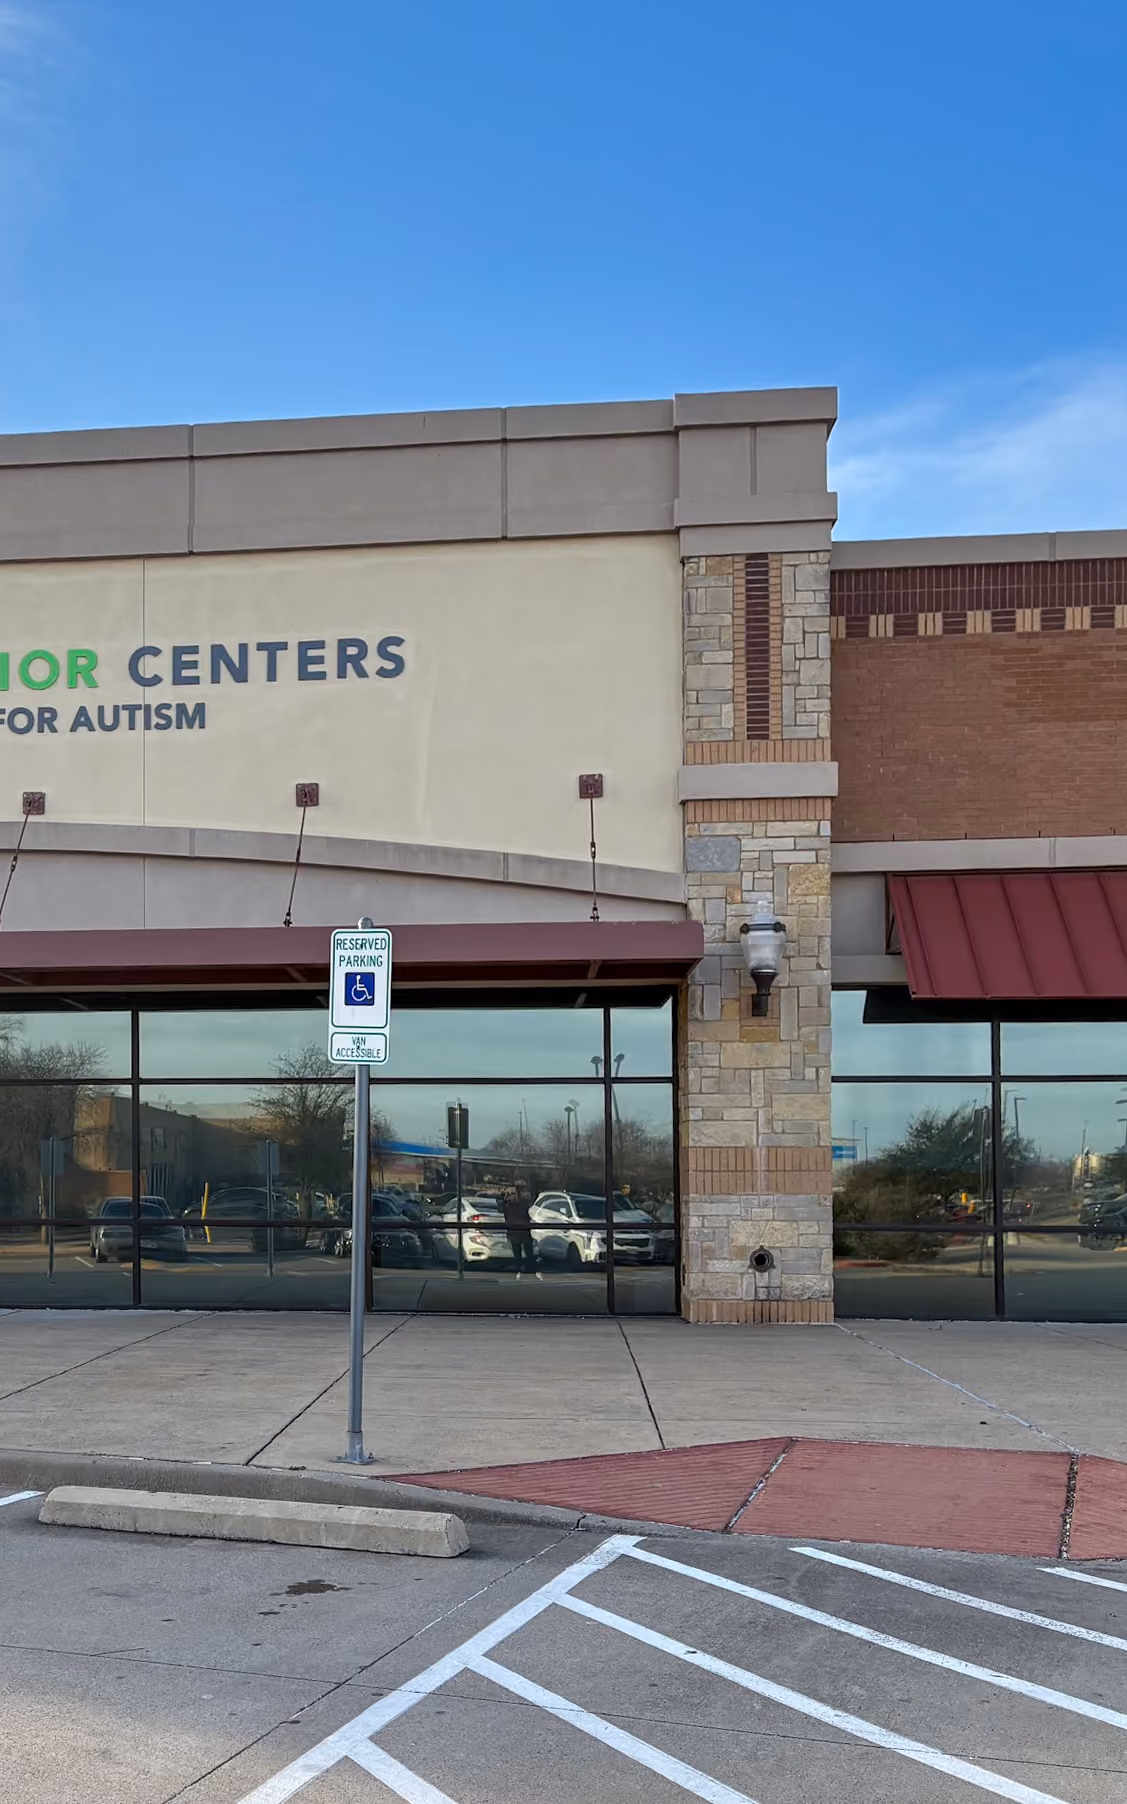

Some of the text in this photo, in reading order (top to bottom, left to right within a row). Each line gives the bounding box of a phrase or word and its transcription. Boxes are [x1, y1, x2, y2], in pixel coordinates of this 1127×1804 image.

[128, 636, 406, 687] CENTERS
[69, 702, 206, 733] AUTISM
[336, 938, 386, 951] RESERVED
[339, 955, 383, 967] PARKING
[352, 1036, 366, 1046] VAN
[336, 1048, 381, 1058] ACCESSIBLE
